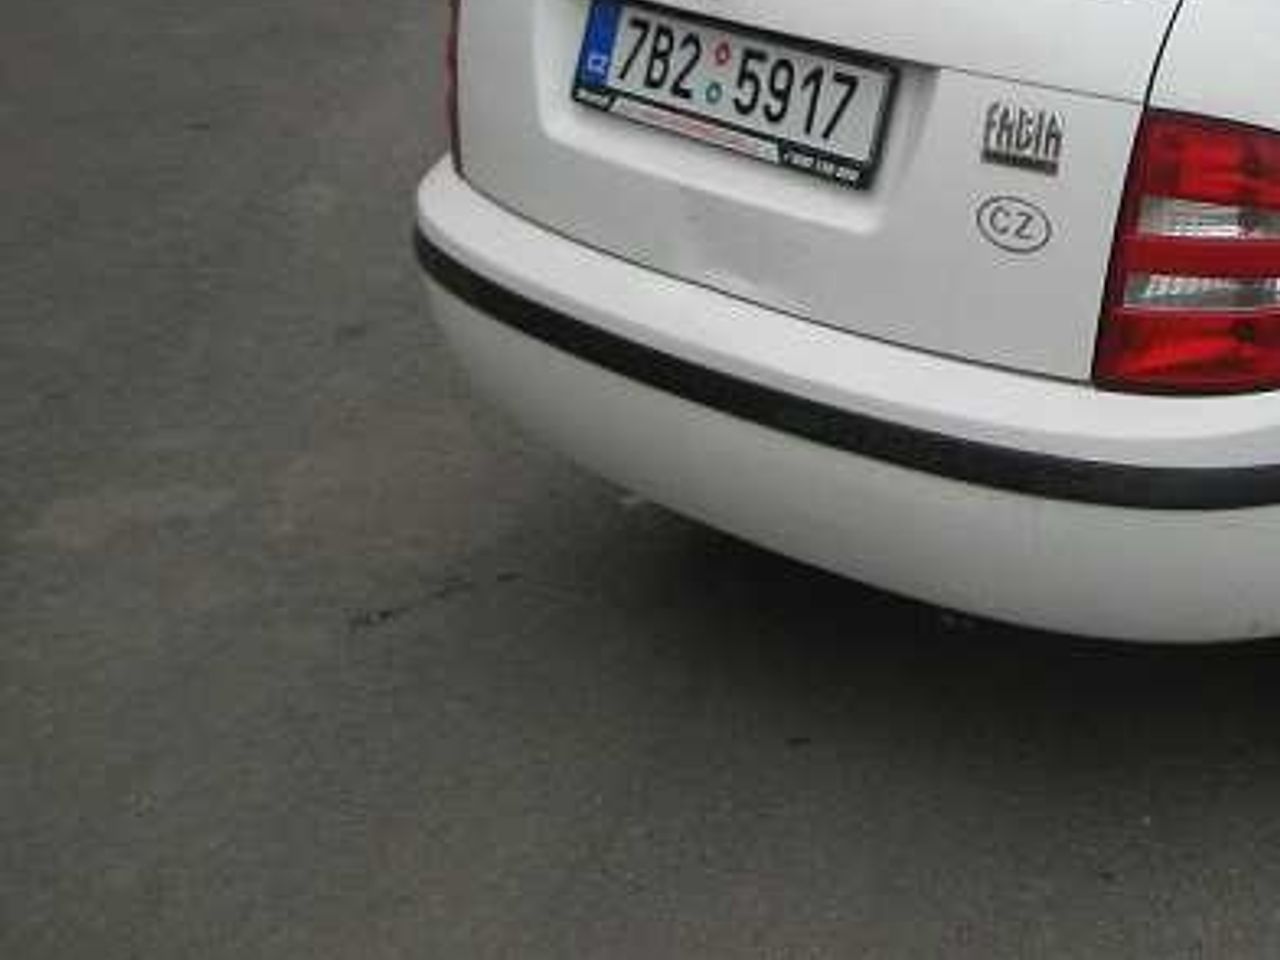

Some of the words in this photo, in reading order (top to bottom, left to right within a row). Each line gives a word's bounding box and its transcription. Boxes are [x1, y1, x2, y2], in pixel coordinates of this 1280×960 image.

[618, 17, 703, 99] 7B2
[732, 47, 861, 140] 5917
[989, 204, 1034, 240] CZ
